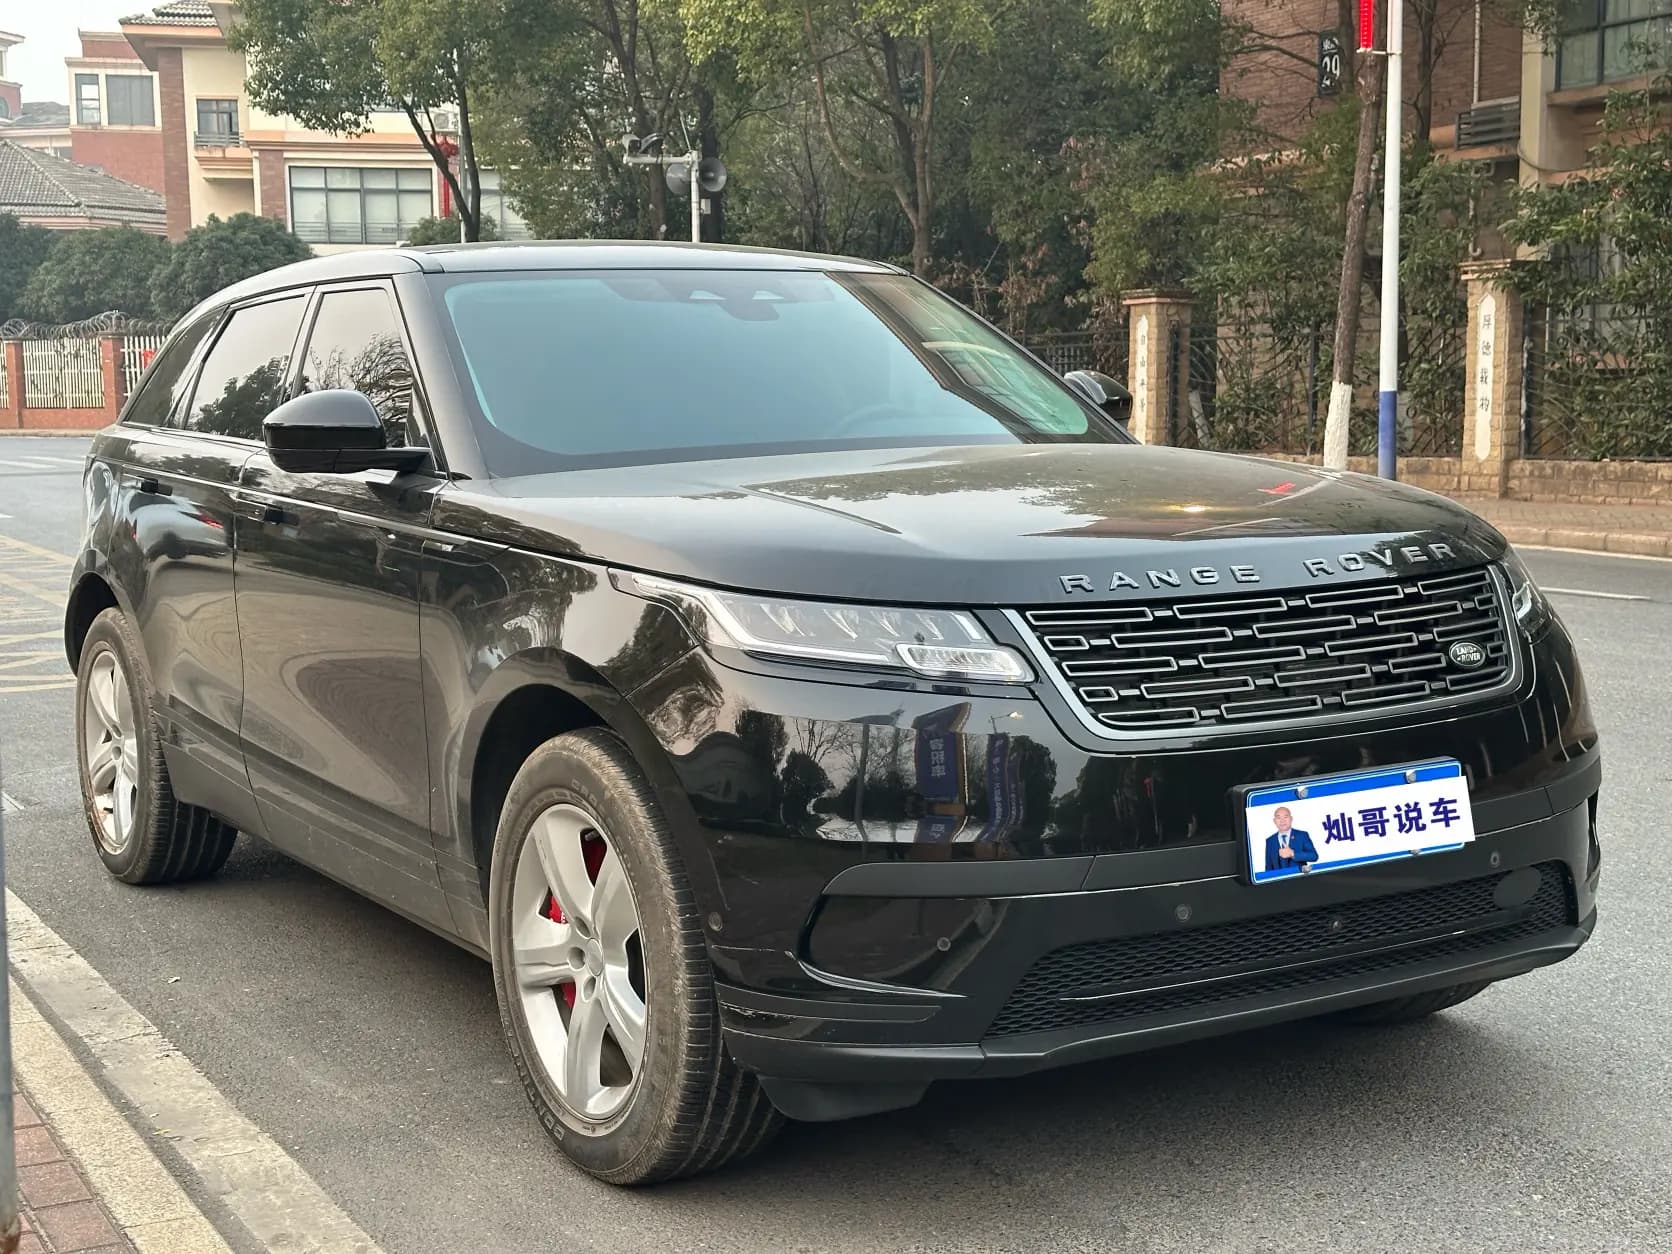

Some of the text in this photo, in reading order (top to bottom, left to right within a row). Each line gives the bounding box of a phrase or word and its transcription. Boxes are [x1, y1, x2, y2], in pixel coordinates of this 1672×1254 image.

[1059, 543, 1457, 593] RANGE ROVER
[1461, 652, 1480, 662] ROVER
